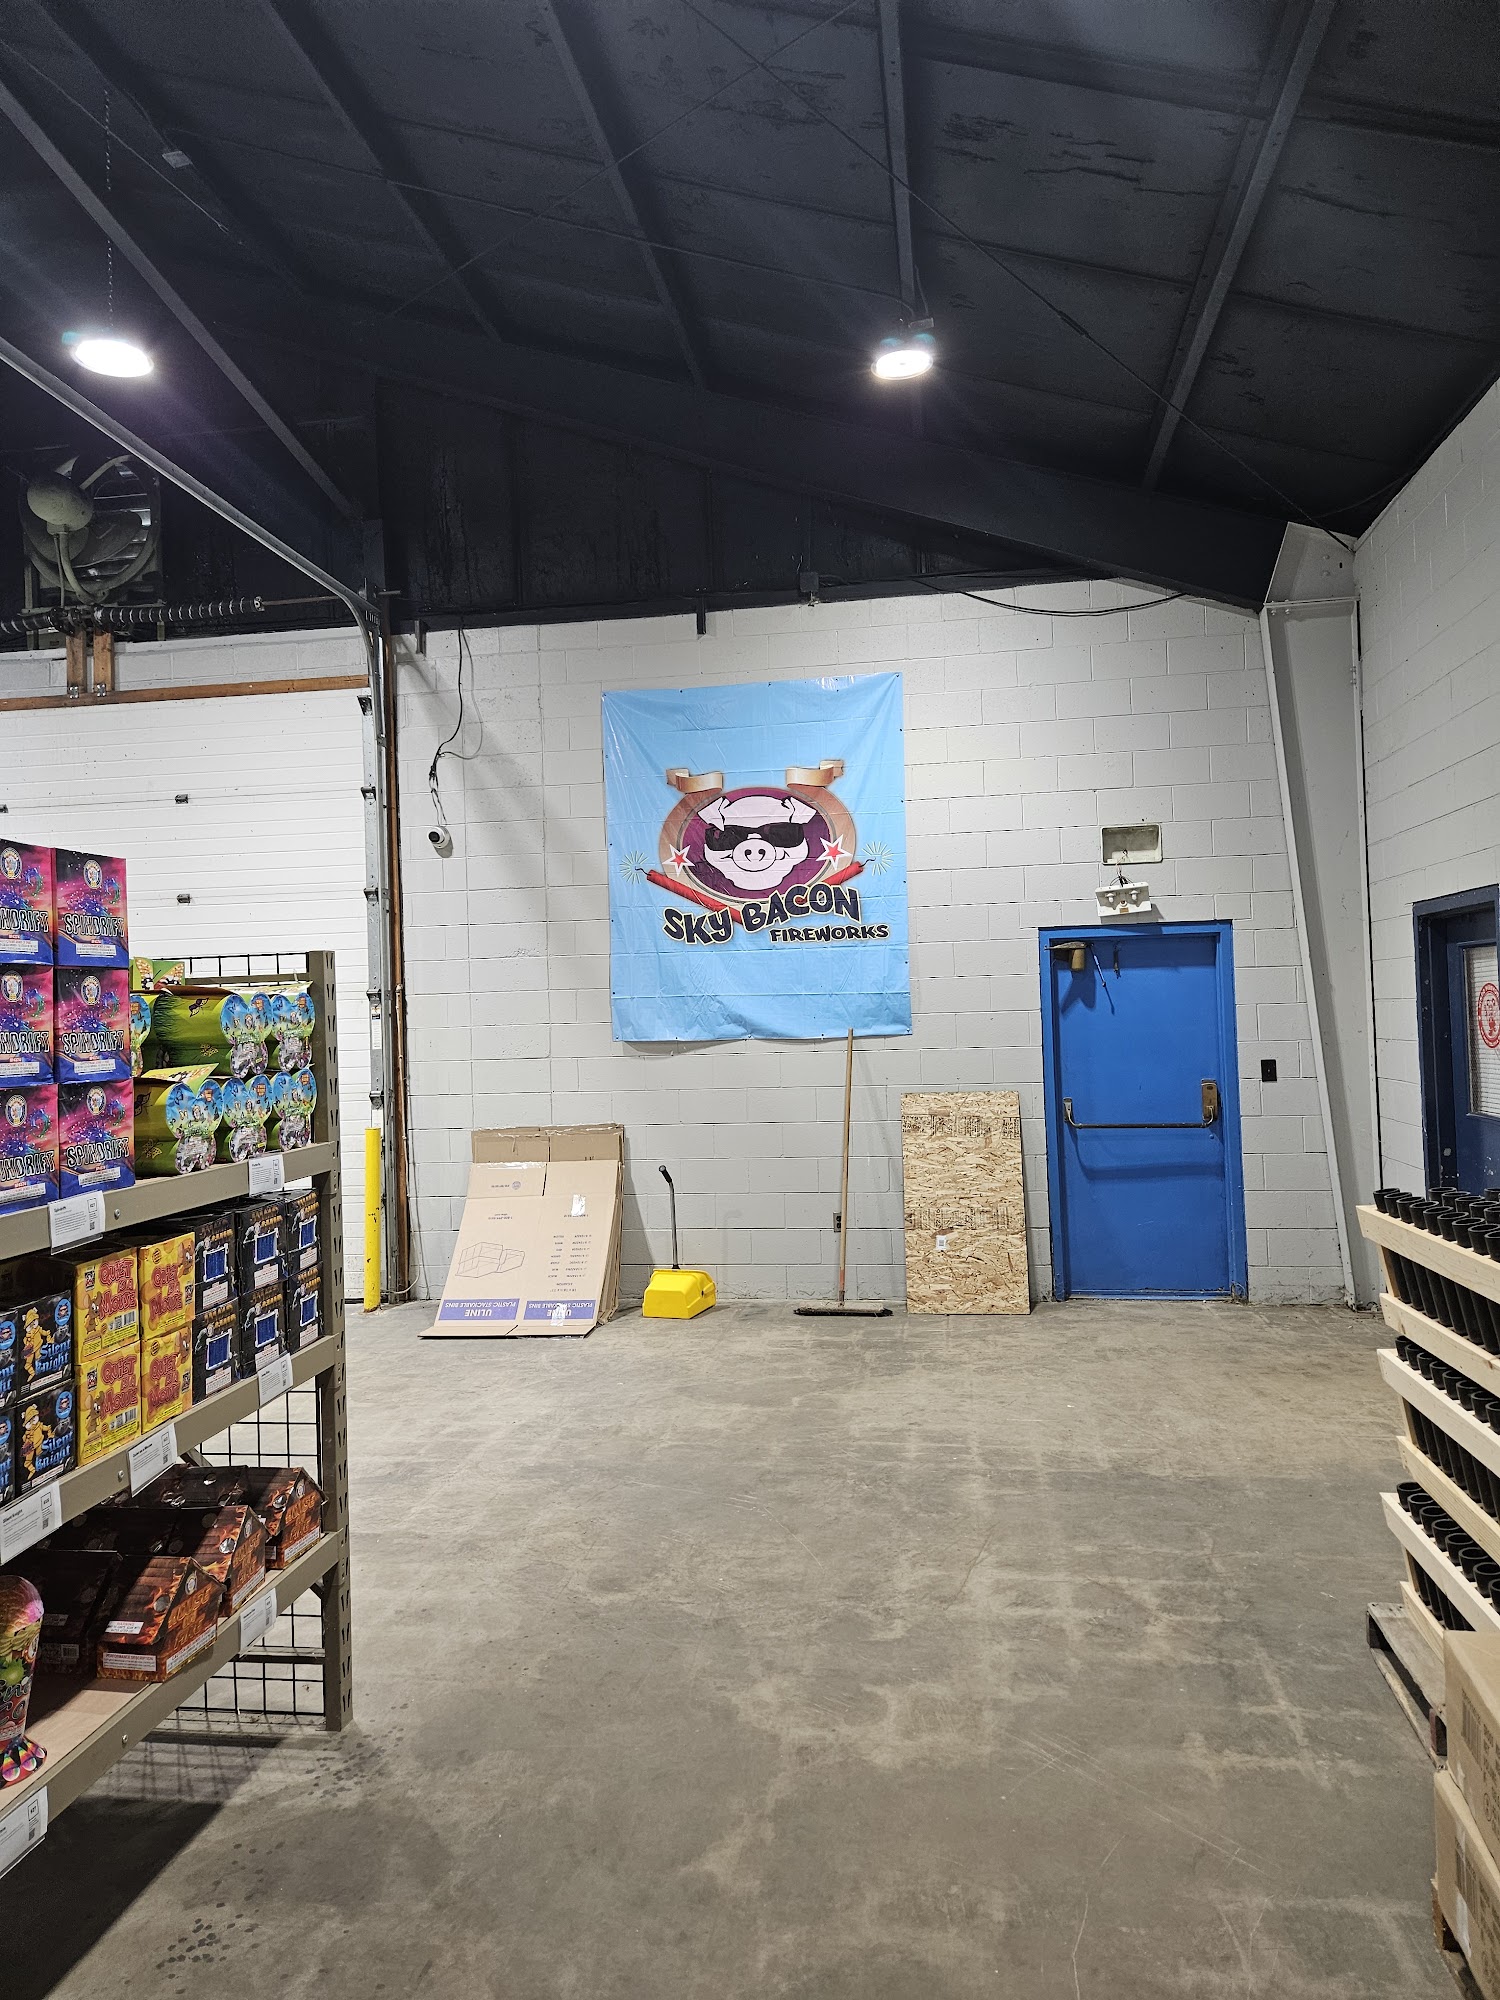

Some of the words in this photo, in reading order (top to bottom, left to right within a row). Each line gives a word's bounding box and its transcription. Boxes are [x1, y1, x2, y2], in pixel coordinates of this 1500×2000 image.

[64, 912, 125, 938] SPINDRIFT
[664, 907, 733, 945] SKY
[741, 883, 862, 932] BACON
[770, 925, 889, 942] FIREWORKS
[62, 1030, 124, 1054] SPINDRIFT
[66, 1137, 130, 1168] SPINDRIFT
[99, 1258, 134, 1286] QUIET
[152, 1264, 179, 1288] QUIET
[100, 1290, 137, 1320] MOUSE
[464, 1309, 492, 1317] ULINE
[40, 1339, 71, 1360] Silent
[101, 1354, 137, 1385] QUIET
[150, 1352, 179, 1380] QUIET
[100, 1387, 138, 1420] MOUSE
[41, 1431, 73, 1453] Silent
